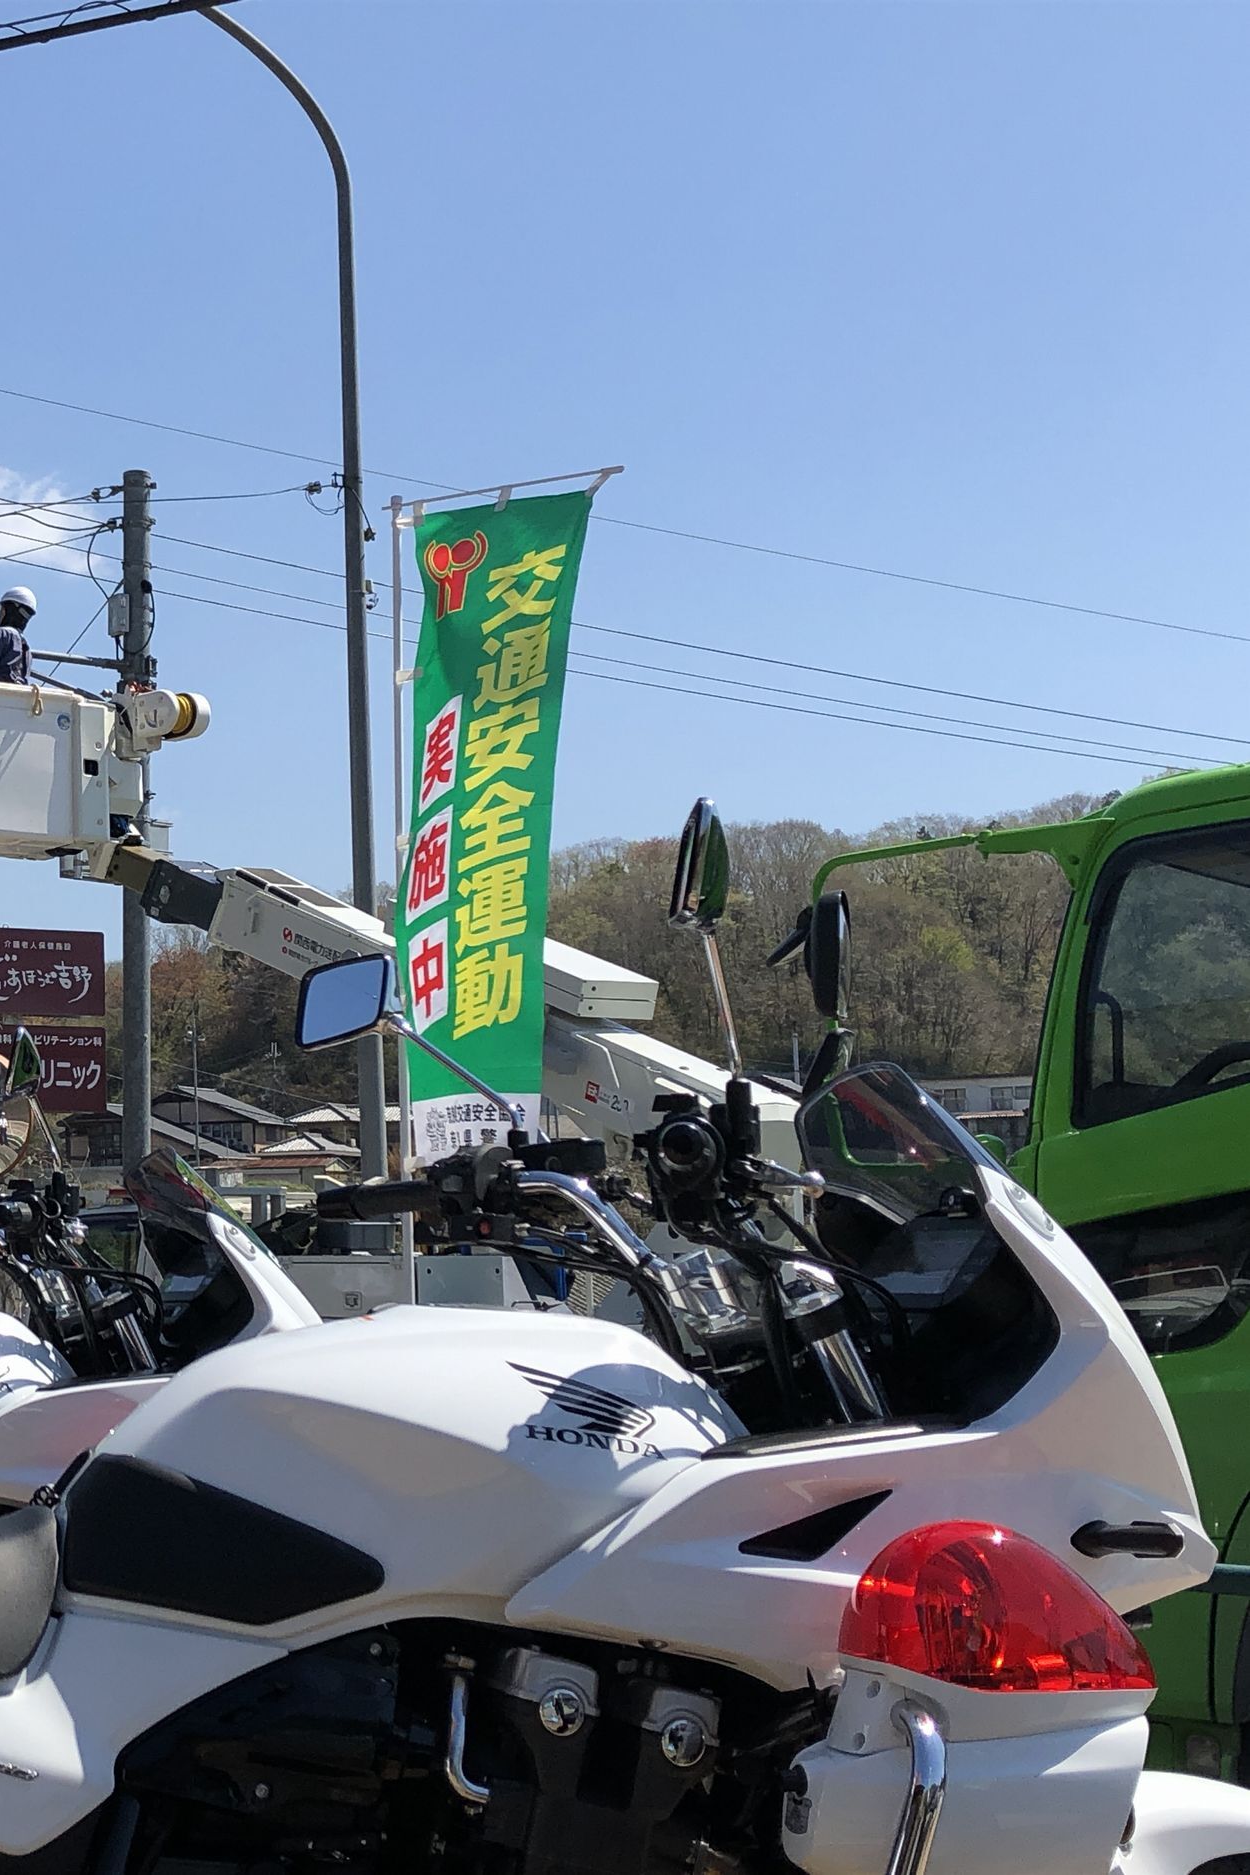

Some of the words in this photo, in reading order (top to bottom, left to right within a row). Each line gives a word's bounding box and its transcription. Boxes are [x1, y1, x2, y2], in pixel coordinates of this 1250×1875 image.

[408, 706, 457, 1022] 実施中
[452, 543, 568, 1041] 交通安全運動
[525, 1423, 668, 1461] HONDA
